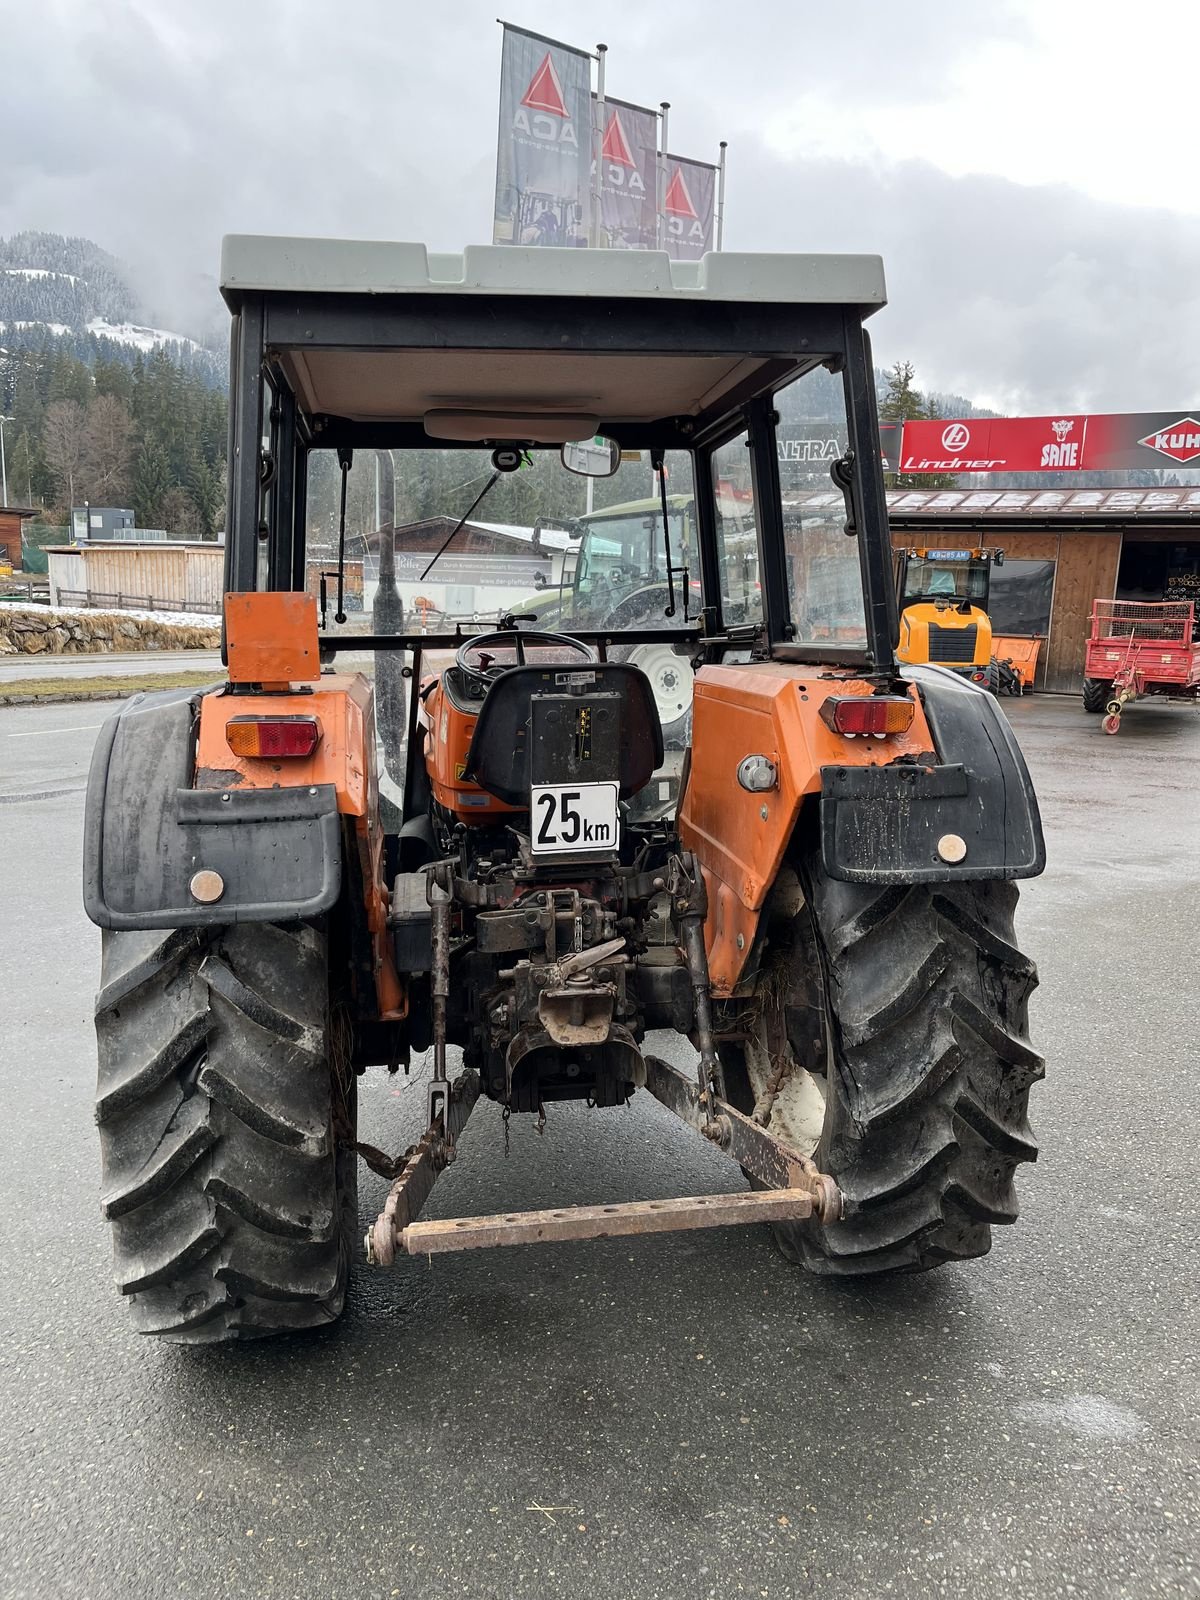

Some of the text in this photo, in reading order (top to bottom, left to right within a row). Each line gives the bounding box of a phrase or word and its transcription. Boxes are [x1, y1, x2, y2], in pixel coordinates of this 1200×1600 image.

[1154, 433, 1200, 449] KUH
[904, 456, 1007, 469] Lindner
[1040, 443, 1078, 467] SAME
